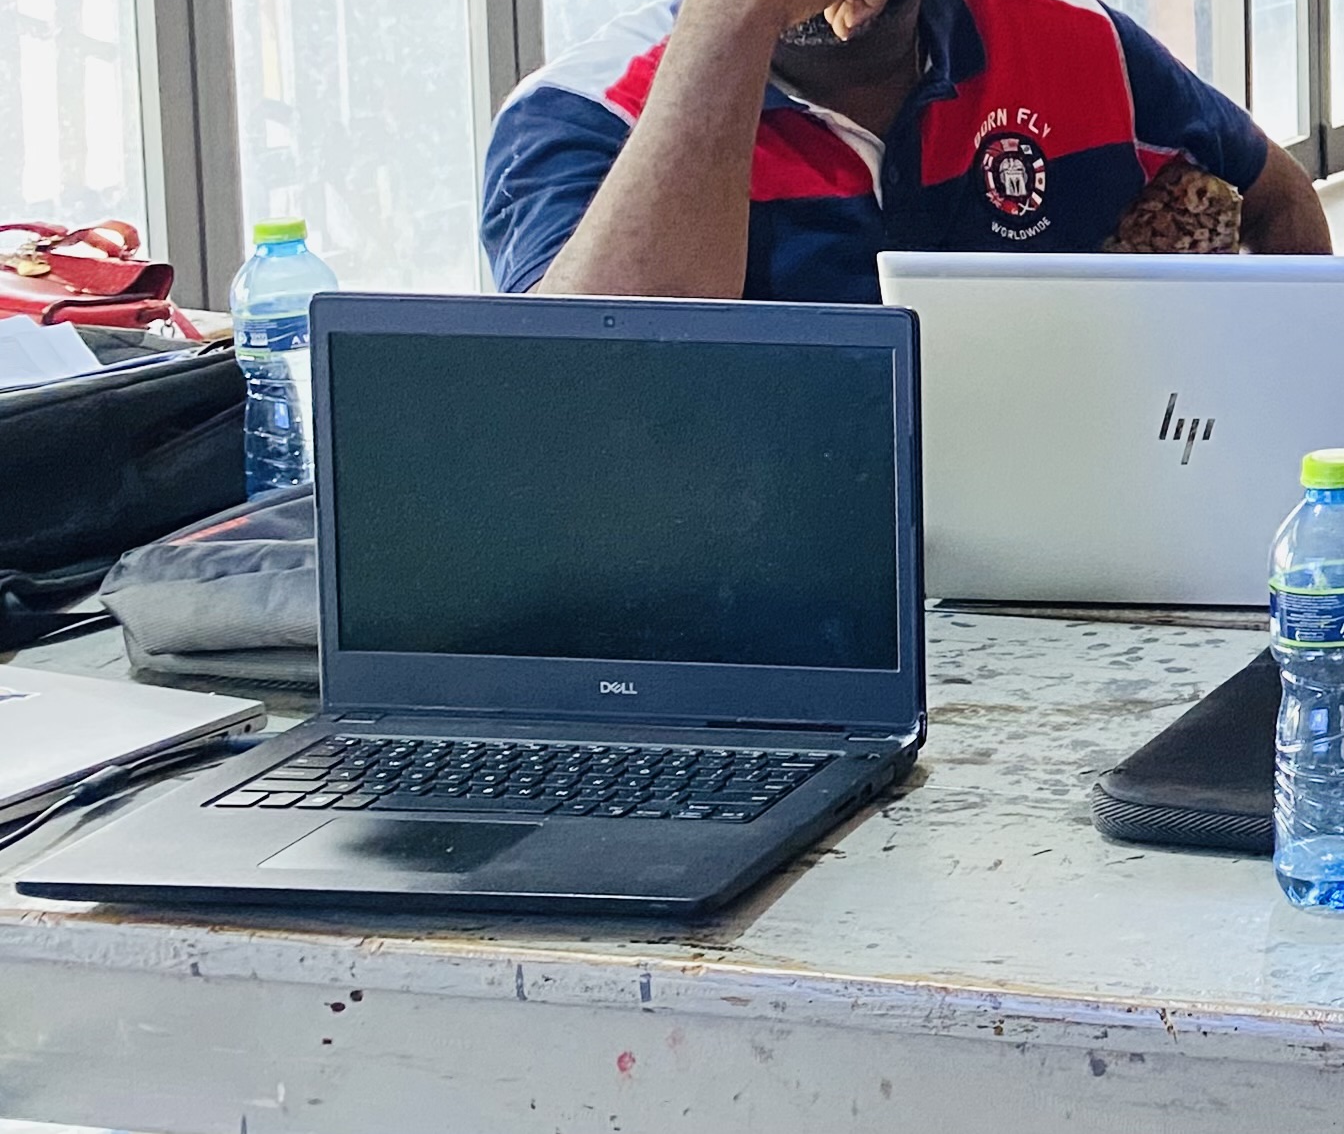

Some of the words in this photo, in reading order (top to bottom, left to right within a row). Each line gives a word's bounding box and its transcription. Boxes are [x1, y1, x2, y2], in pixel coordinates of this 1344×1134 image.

[1016, 107, 1052, 139] FLY
[990, 216, 1052, 241] WORLDWIDE
[1159, 392, 1216, 466] hp
[600, 681, 638, 695] DELL
